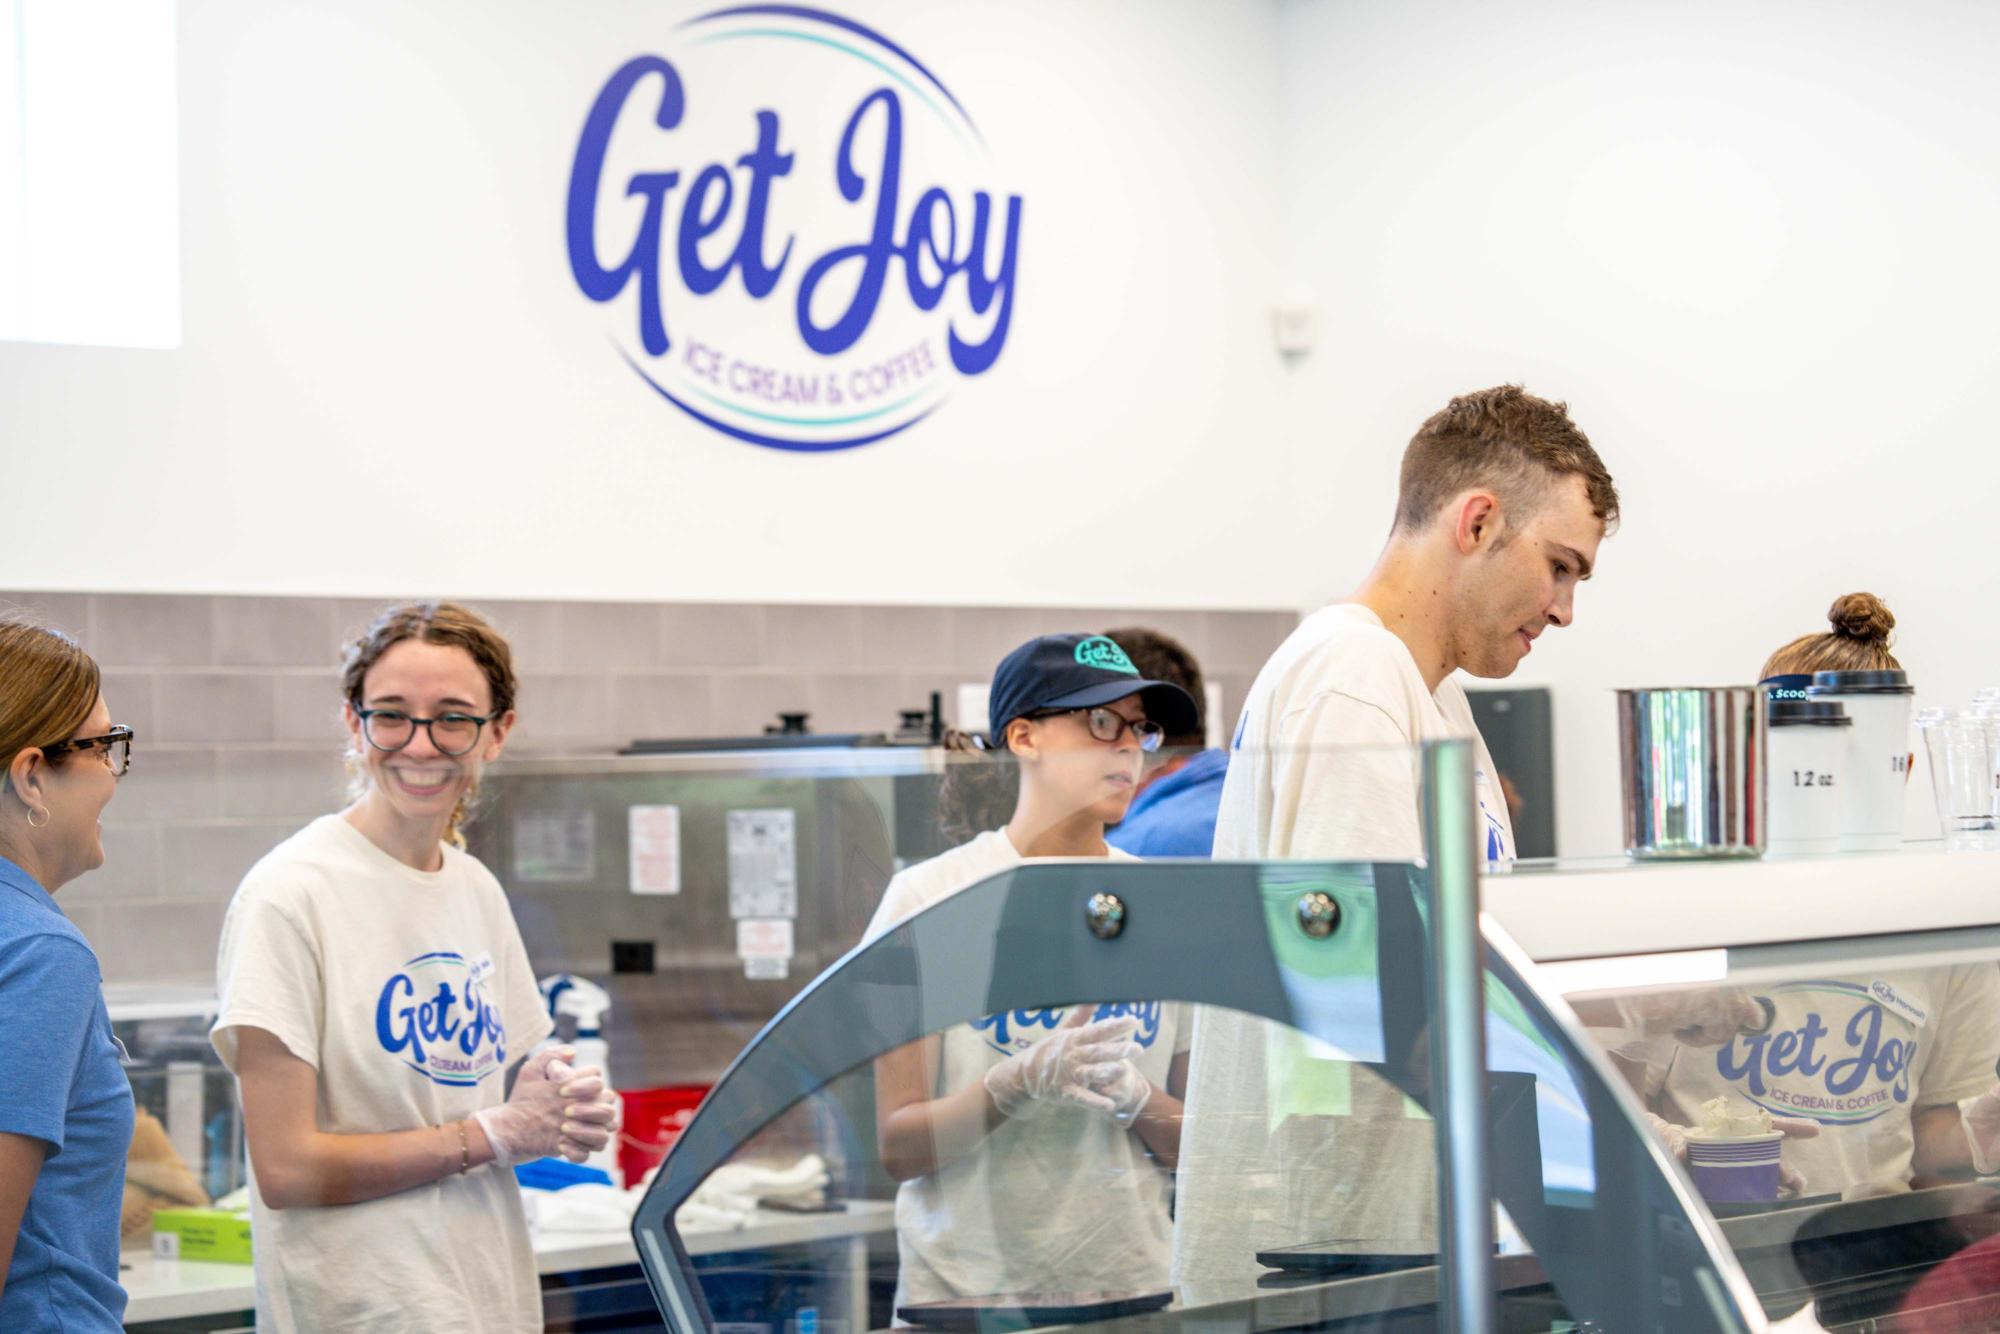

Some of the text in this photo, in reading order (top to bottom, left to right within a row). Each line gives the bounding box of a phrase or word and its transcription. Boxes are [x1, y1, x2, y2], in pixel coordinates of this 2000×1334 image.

[566, 55, 1023, 376] Get Joy
[683, 337, 723, 386] ICE
[728, 360, 819, 404] CREAM
[848, 339, 936, 401] COFFEE
[1776, 688, 1810, 701] Scoo
[1793, 770, 1815, 787] 12
[375, 972, 462, 1065] Get
[1716, 1003, 1918, 1104] Get Joy
[1770, 1087, 1790, 1104] ICE
[1836, 1100, 1845, 1111] &
[1847, 1088, 1889, 1110] COFFEE
